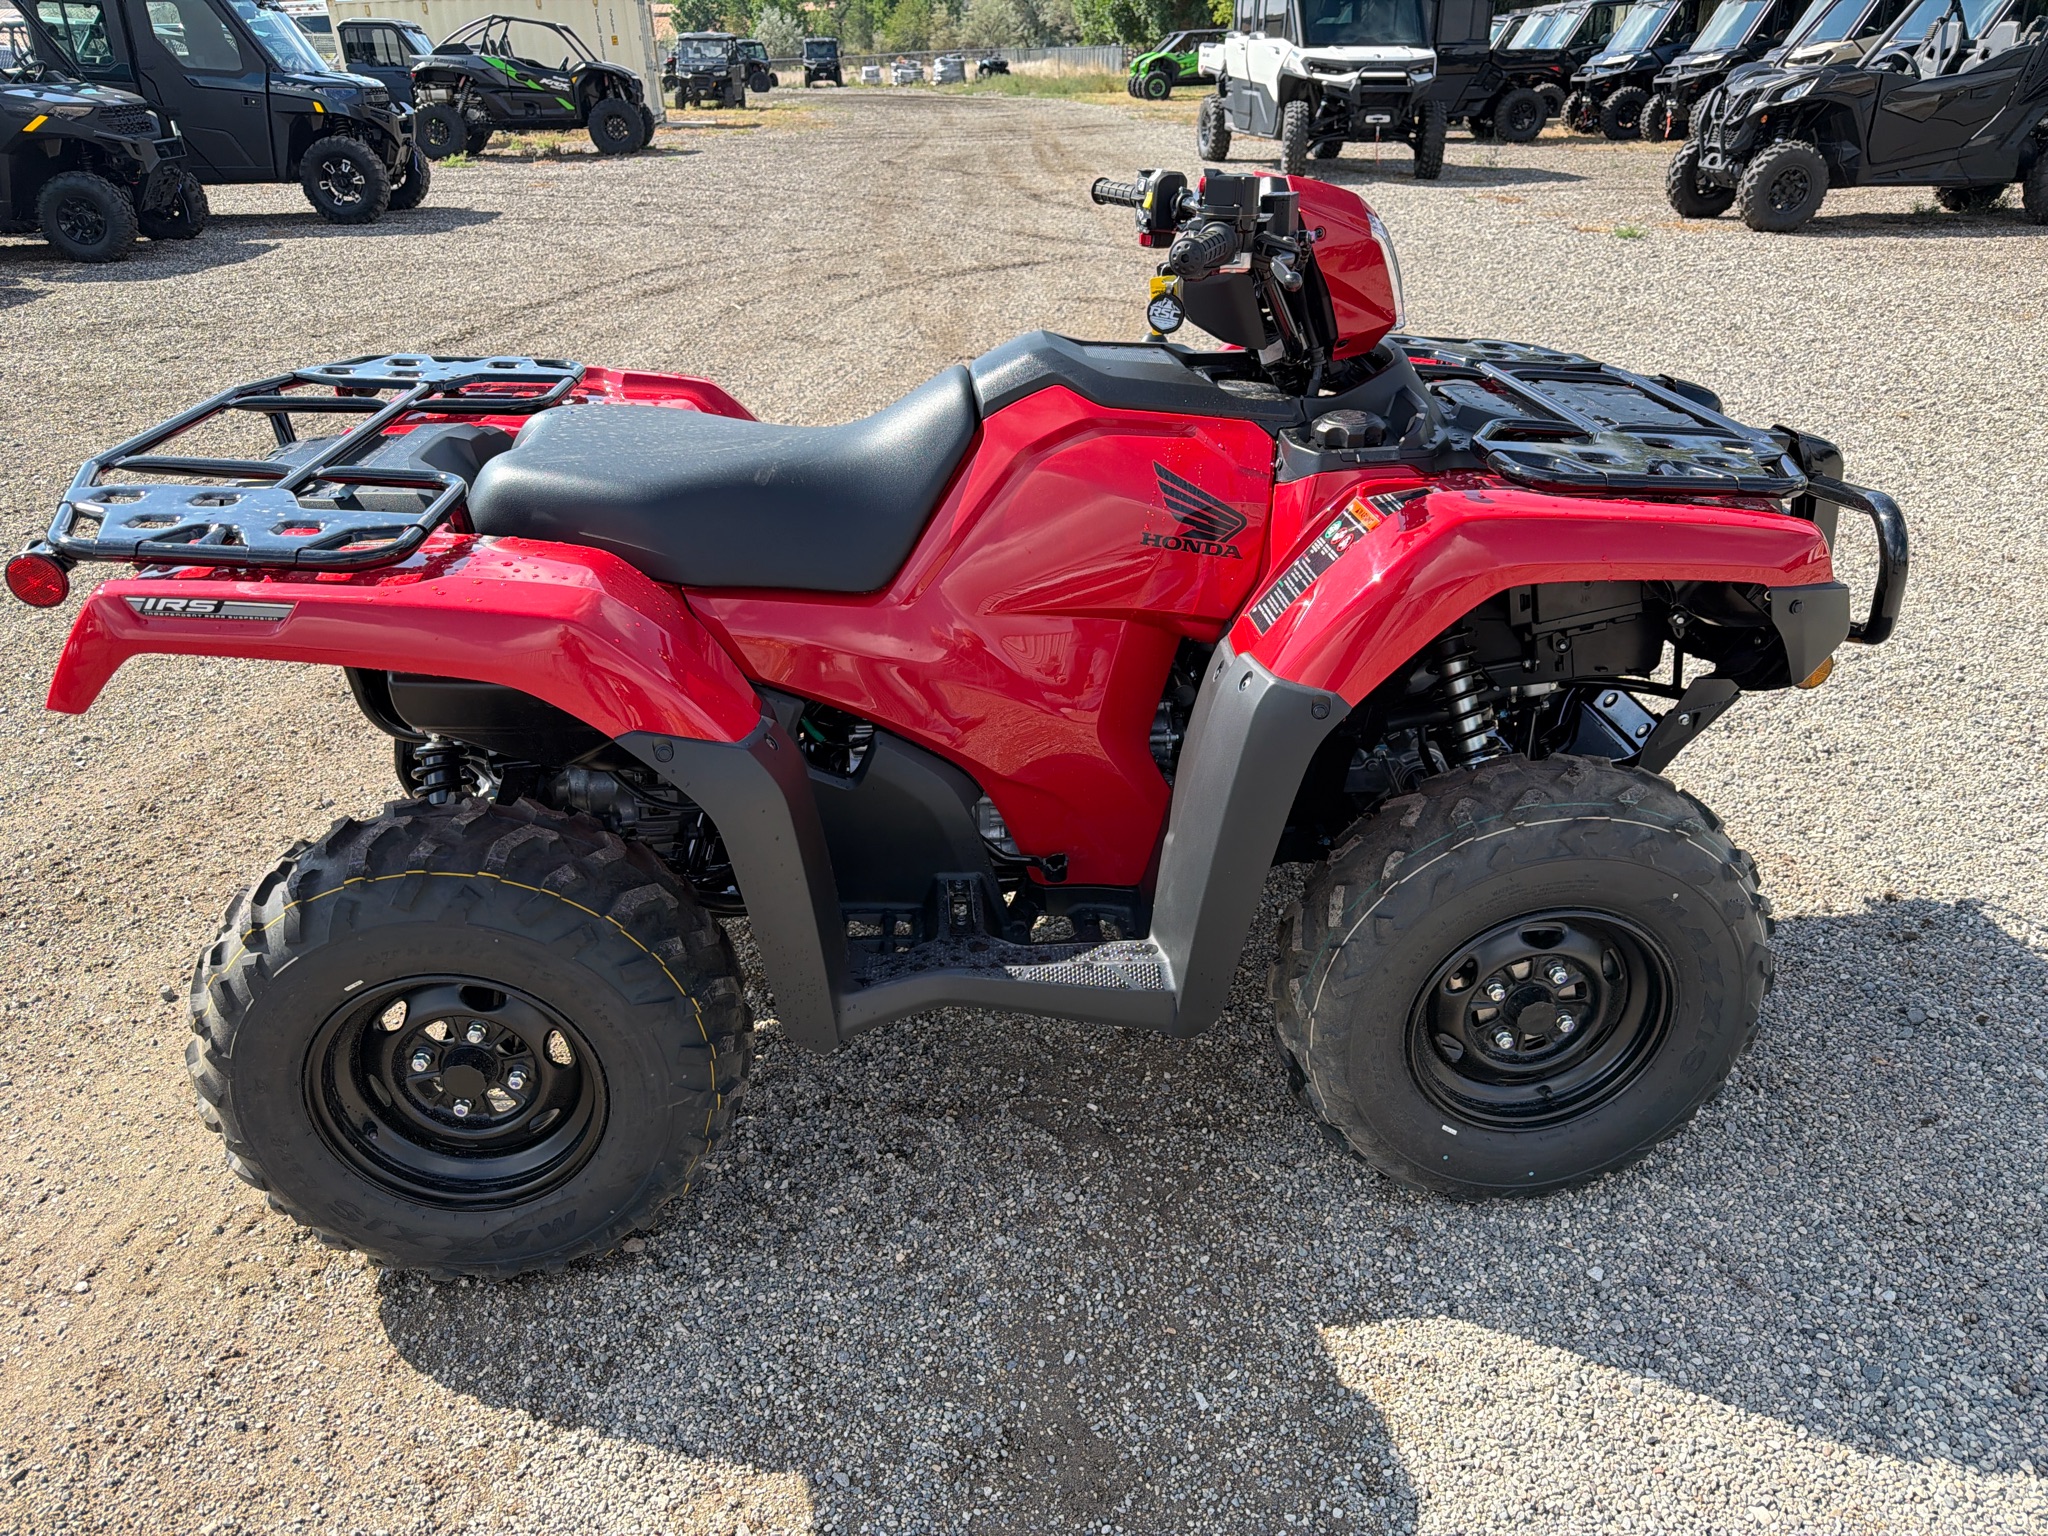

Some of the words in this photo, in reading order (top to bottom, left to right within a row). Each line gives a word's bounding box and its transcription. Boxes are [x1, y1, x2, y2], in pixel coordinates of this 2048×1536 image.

[434, 56, 468, 66] Kawasaki
[1148, 305, 1181, 321] RSC
[1140, 531, 1243, 560] HONDA
[144, 597, 219, 613] IRS
